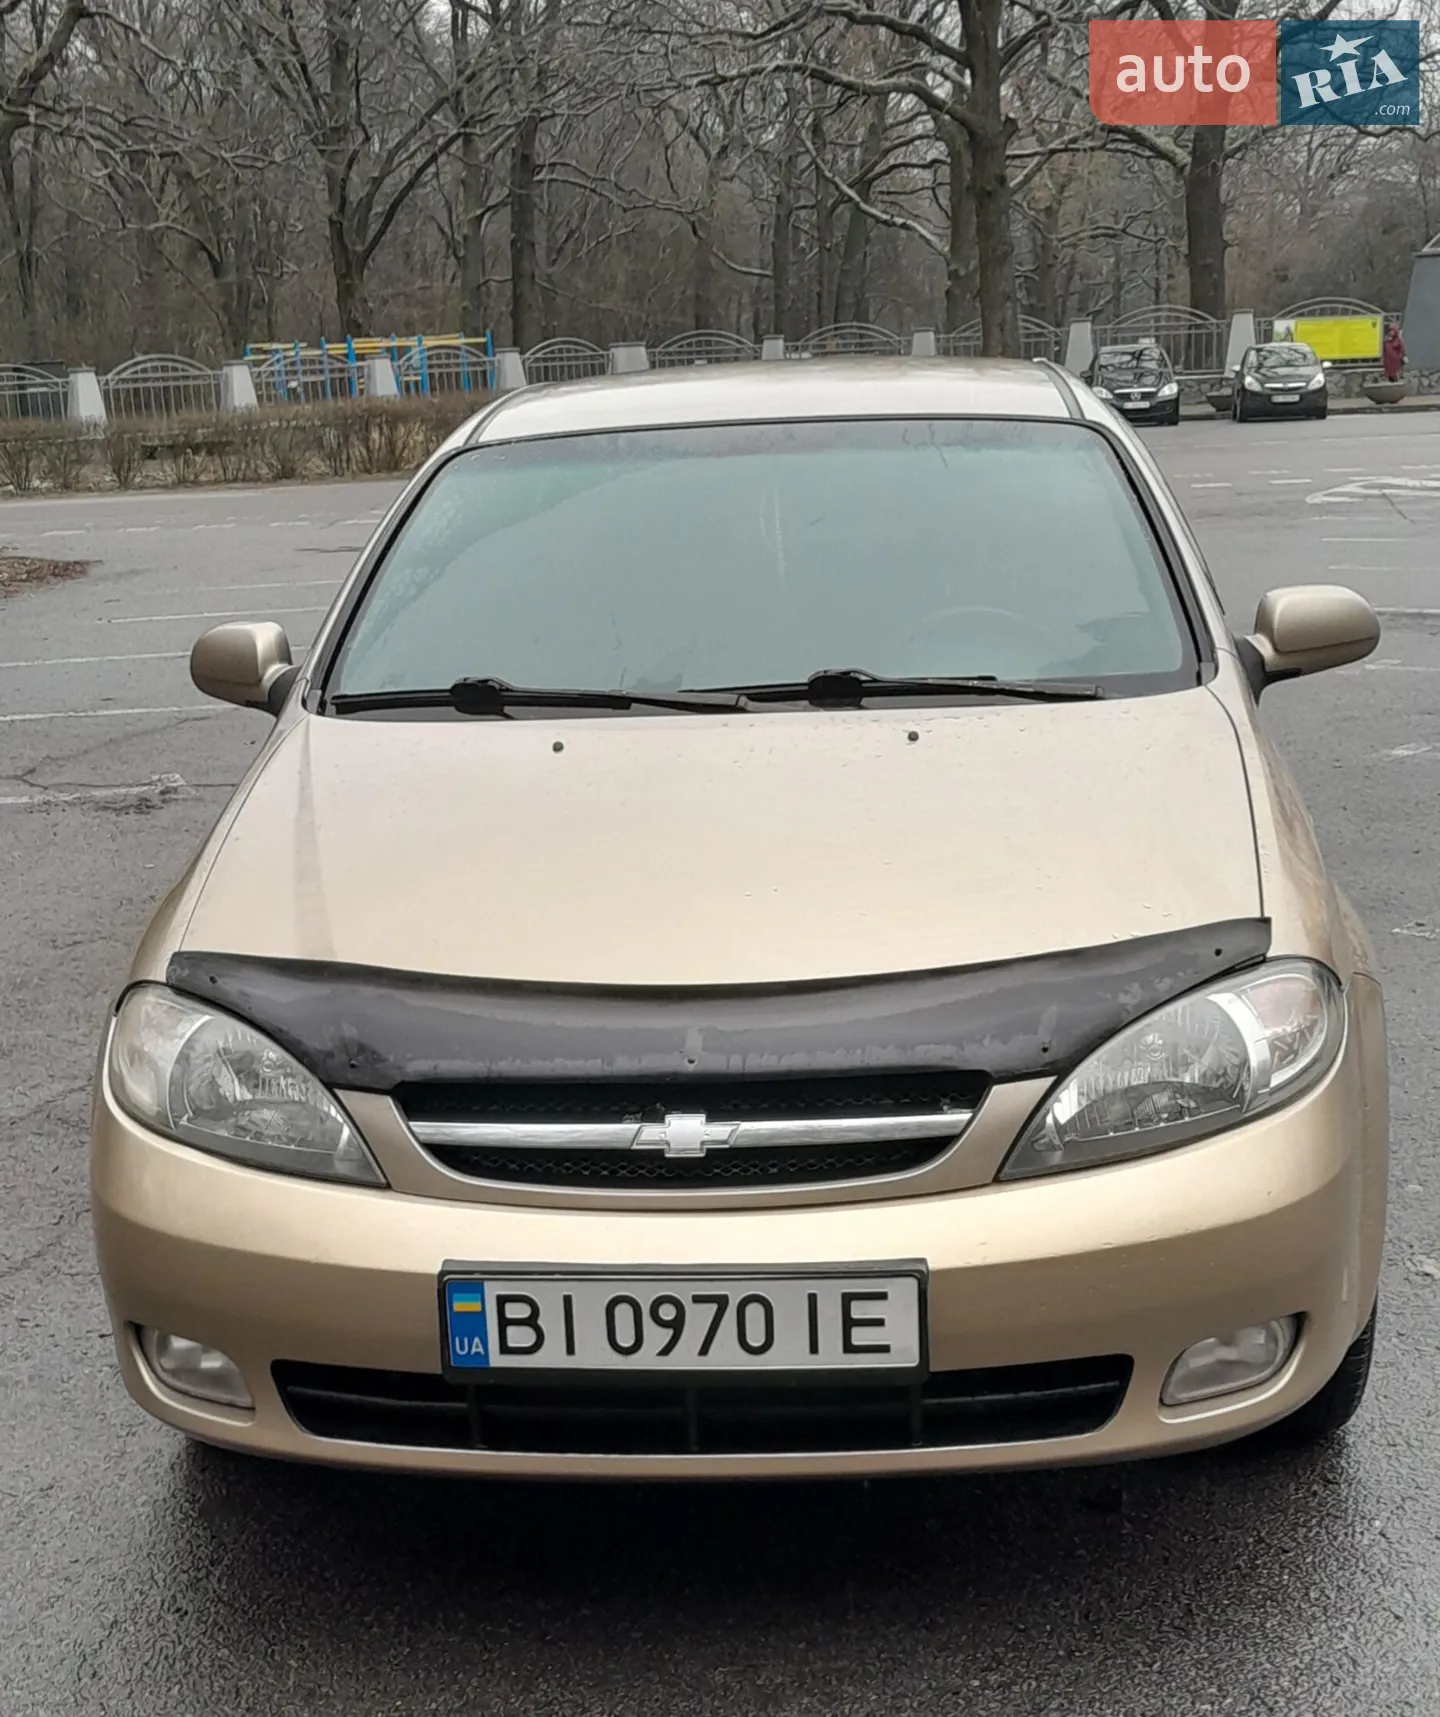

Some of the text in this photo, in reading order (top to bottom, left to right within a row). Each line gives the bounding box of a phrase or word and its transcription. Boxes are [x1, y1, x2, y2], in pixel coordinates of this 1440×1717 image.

[495, 1291, 892, 1357] BI 0970 IE
[455, 1336, 485, 1356] UA
